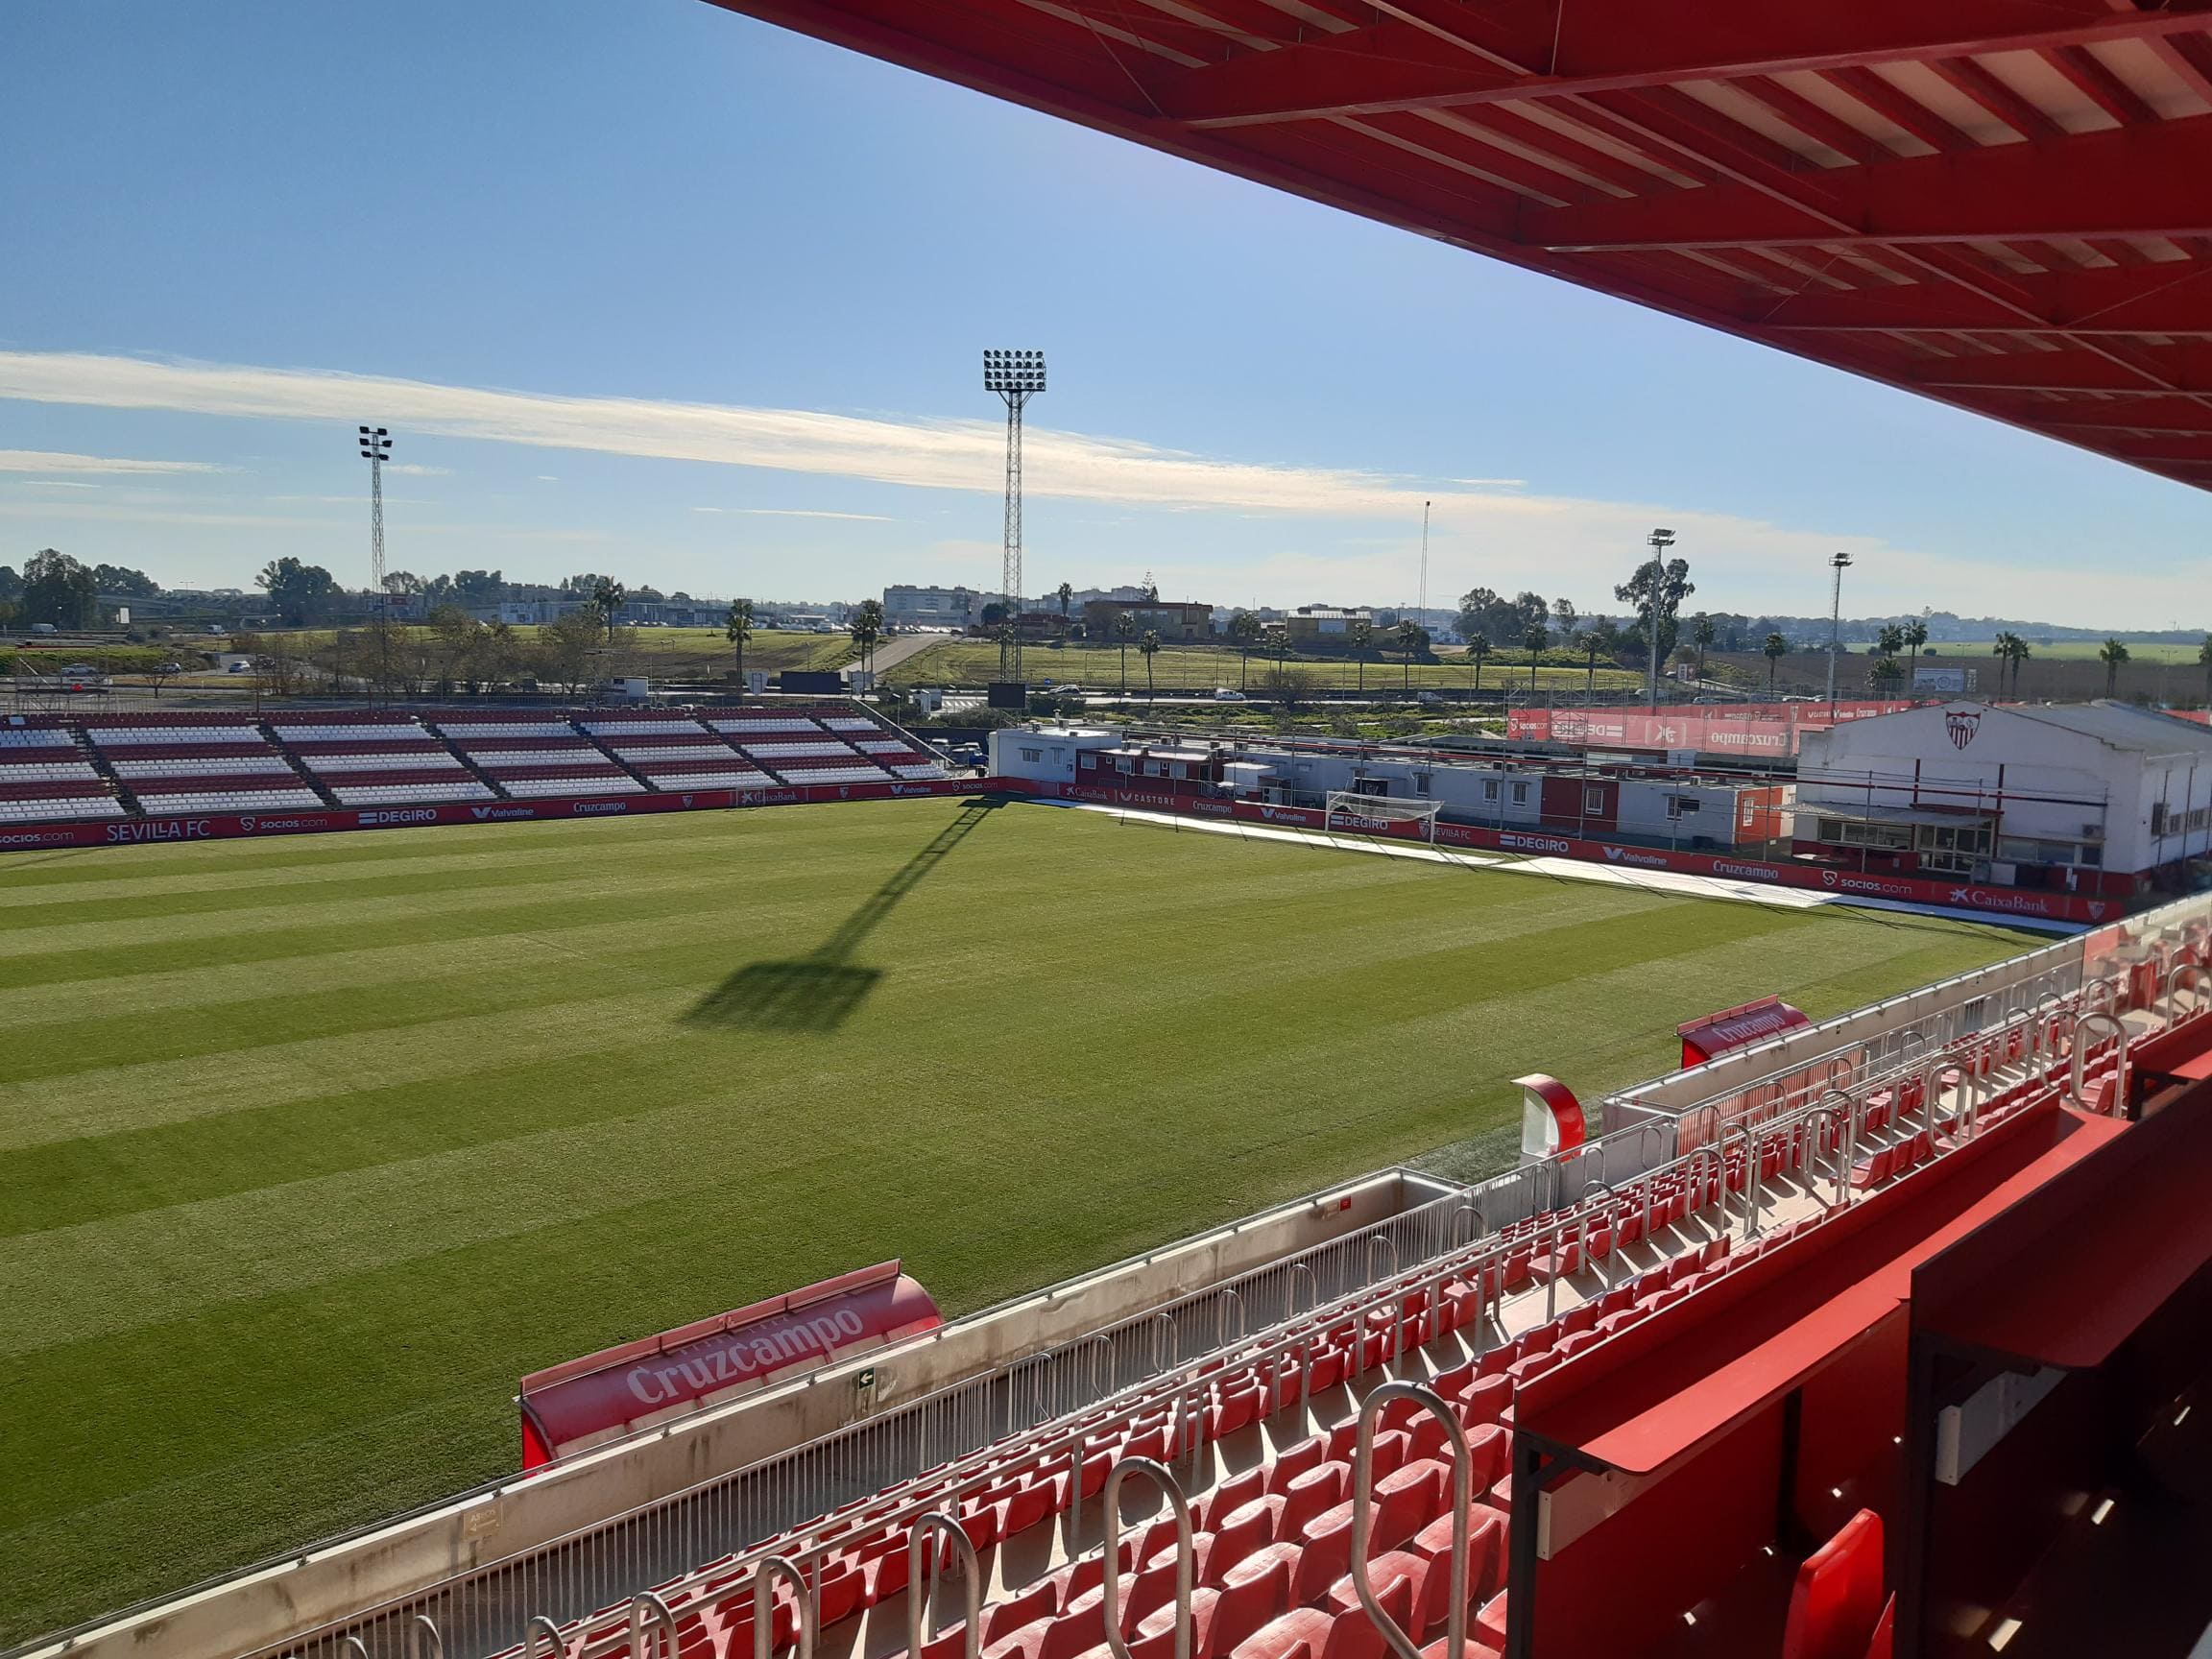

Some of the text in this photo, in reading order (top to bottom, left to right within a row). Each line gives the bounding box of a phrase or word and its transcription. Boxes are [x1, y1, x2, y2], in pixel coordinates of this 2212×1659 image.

[1134, 793, 1175, 805] CASTORE
[492, 806, 534, 818] Valvoline
[573, 802, 626, 813] Cruzcampo
[1192, 800, 1233, 814] Cruzcampo
[378, 808, 437, 824] DEGIRO
[1274, 811, 1307, 823] Valvoline
[1345, 816, 1388, 830] DEGIRO
[0, 831, 74, 844] ocios.com
[107, 820, 210, 842] SEVILLA FC
[1516, 835, 1569, 853] DEGIRO
[1623, 852, 1667, 865] Valvoline
[1713, 860, 1778, 879] Cruzcampo
[1972, 890, 2048, 912] CaixaBank
[1712, 1013, 1786, 1043] Cruzcampo
[626, 1306, 864, 1405] Cruzcampo
